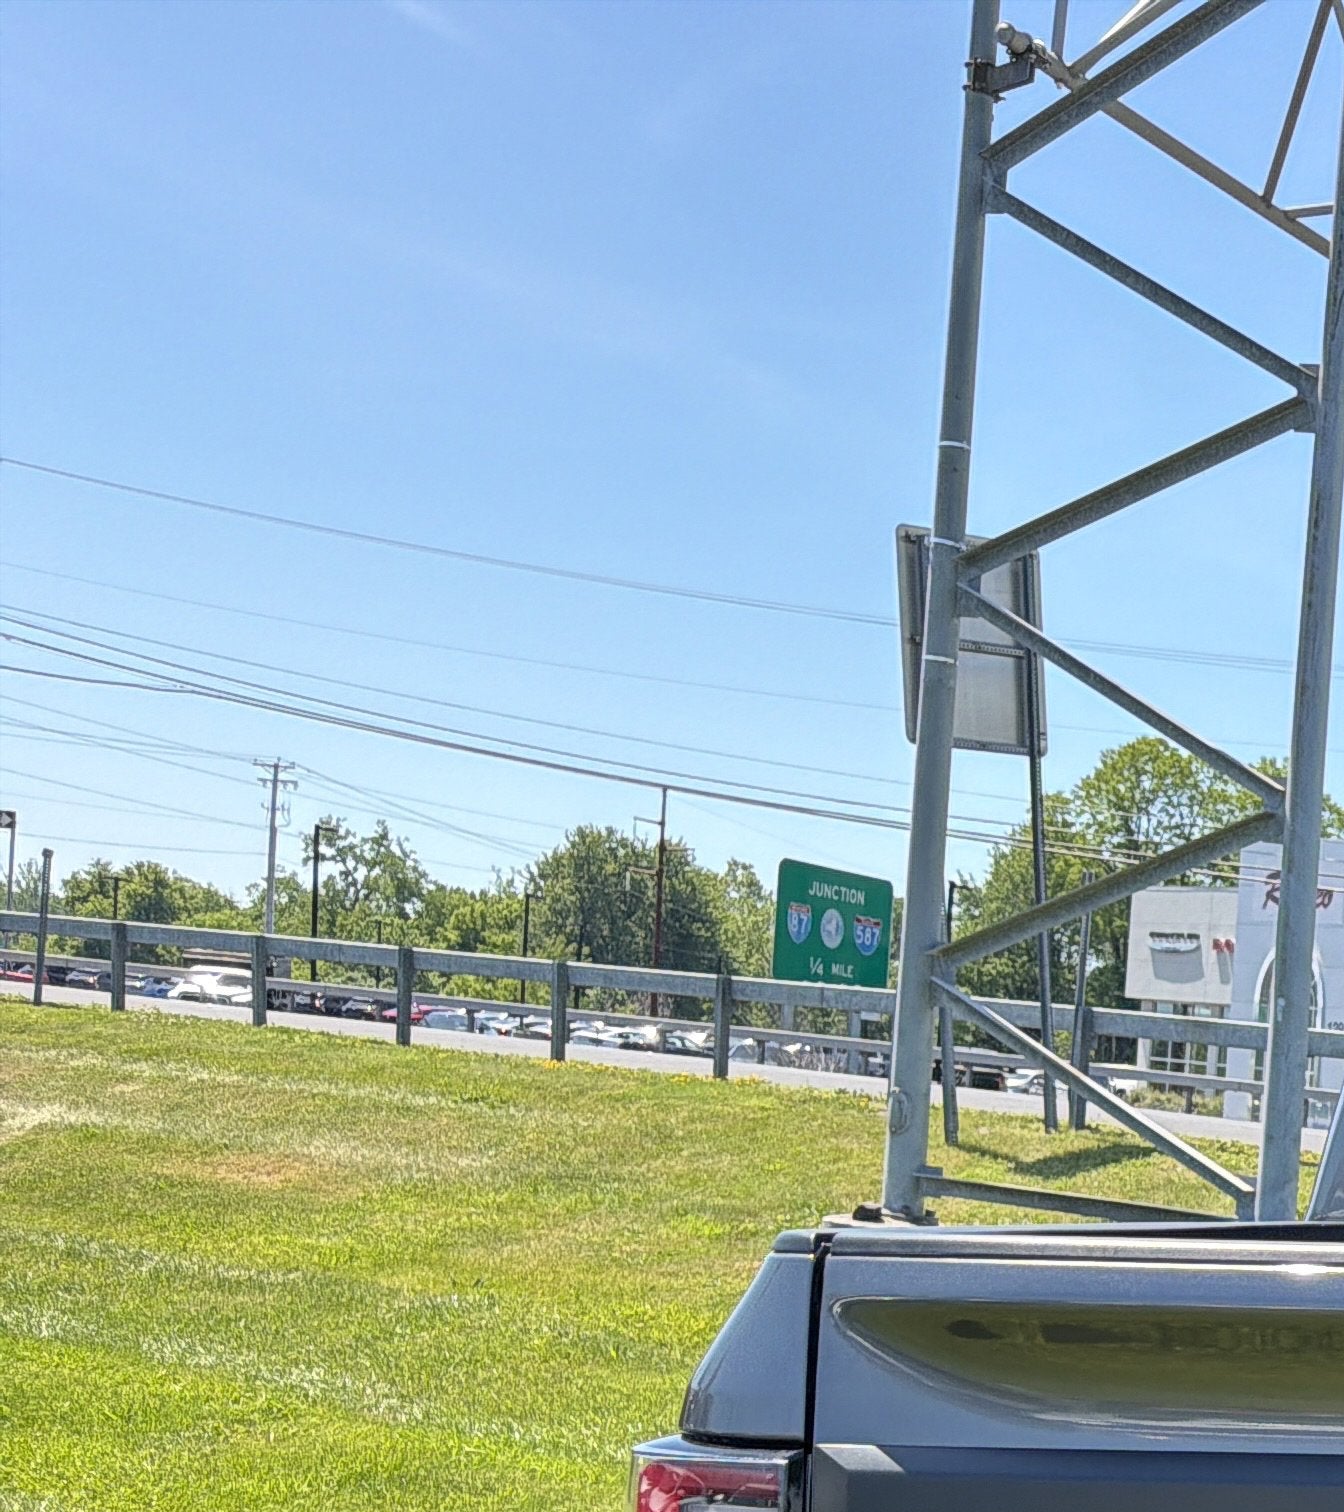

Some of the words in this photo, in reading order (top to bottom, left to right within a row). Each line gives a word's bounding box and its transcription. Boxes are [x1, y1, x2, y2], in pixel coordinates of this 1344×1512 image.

[808, 881, 866, 906] JUNCTION
[791, 913, 809, 934] 87
[855, 925, 881, 946] 587
[831, 962, 854, 979] MILE
